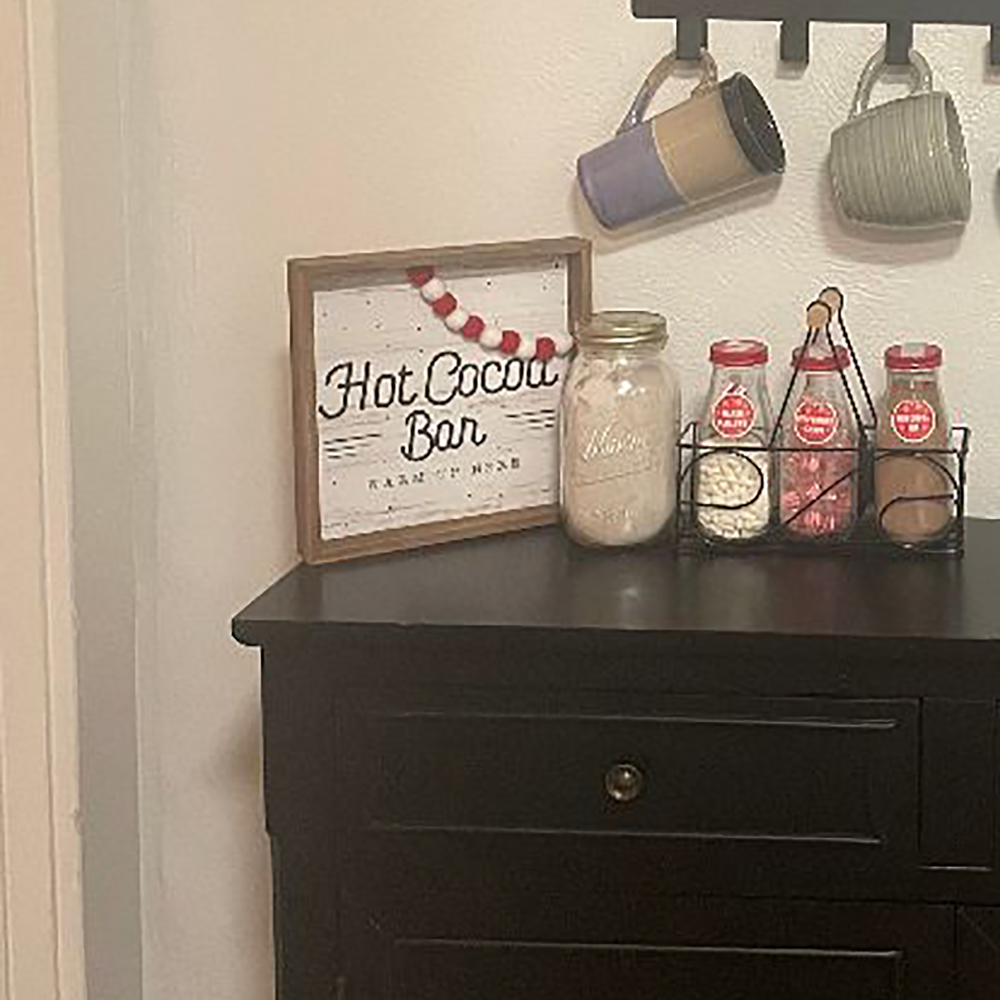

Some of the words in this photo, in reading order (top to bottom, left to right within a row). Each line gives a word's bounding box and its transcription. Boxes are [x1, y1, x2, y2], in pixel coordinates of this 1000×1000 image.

[318, 361, 418, 419] Hot
[424, 351, 559, 406] Cocoa
[400, 409, 487, 462] Bar
